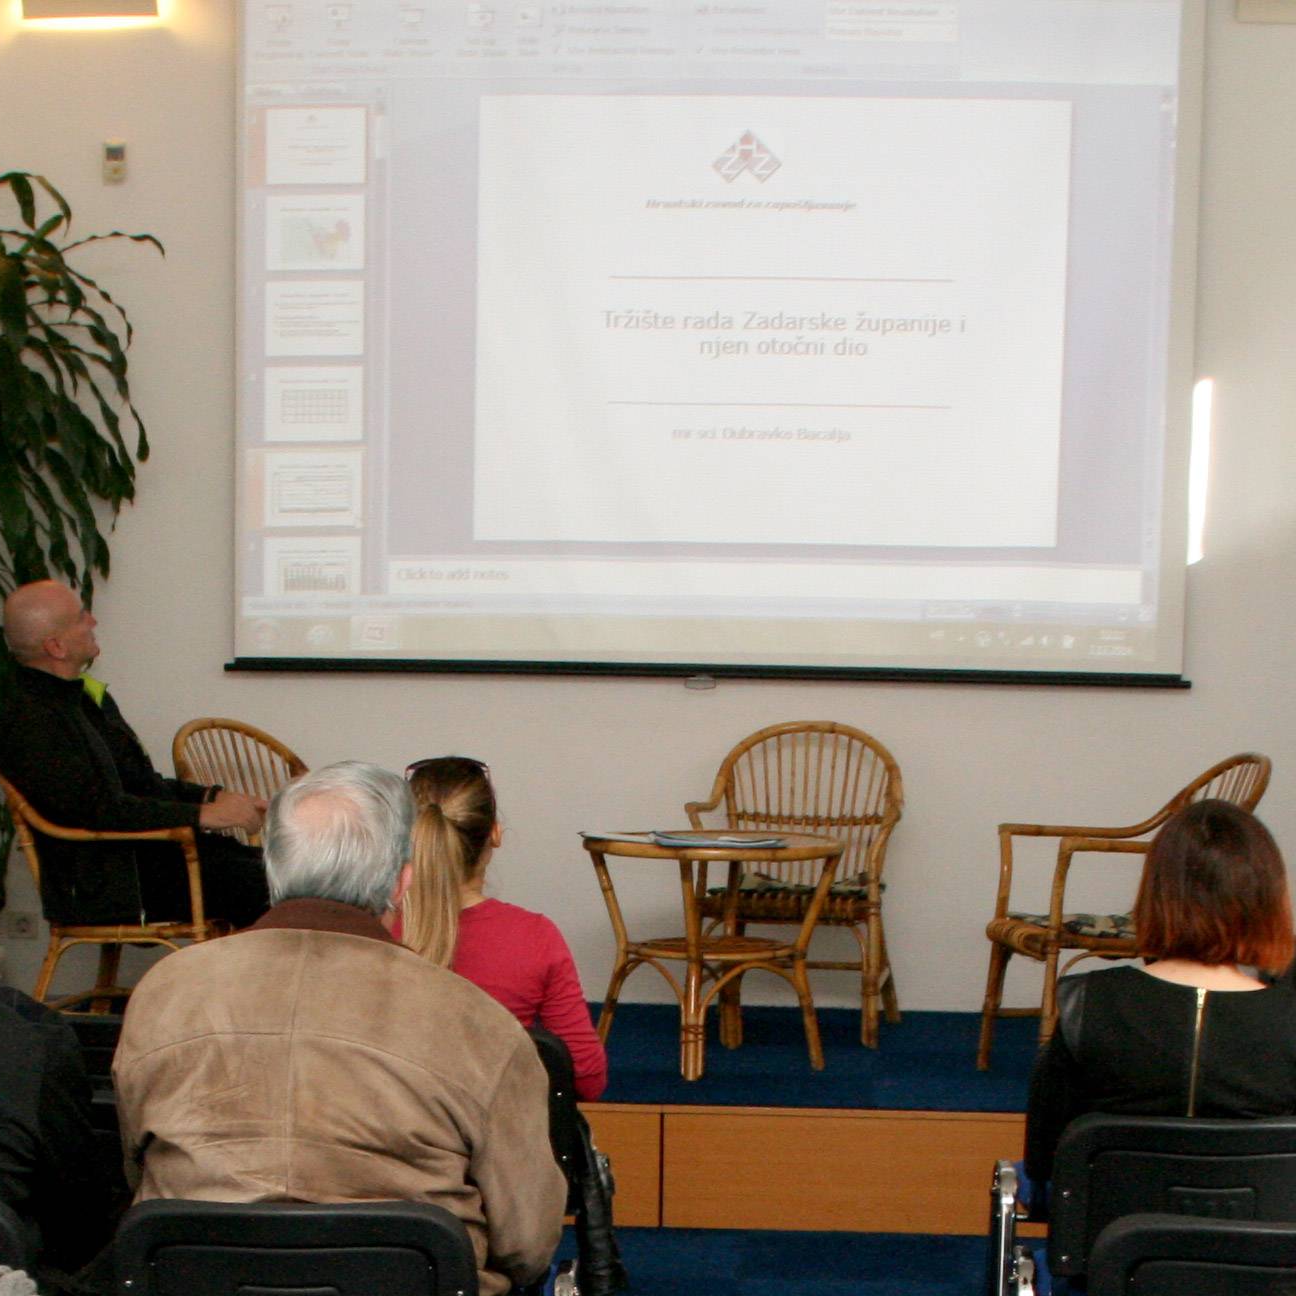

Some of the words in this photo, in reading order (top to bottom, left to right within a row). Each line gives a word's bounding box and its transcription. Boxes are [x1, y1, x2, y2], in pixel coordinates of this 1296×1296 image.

[603, 309, 675, 330] Tržište
[682, 311, 734, 331] rada
[742, 311, 847, 332] Zadarske
[855, 311, 952, 337] županije
[959, 314, 967, 333] i
[700, 338, 749, 359] njen
[757, 335, 825, 356] otočni
[833, 337, 868, 357] dio
